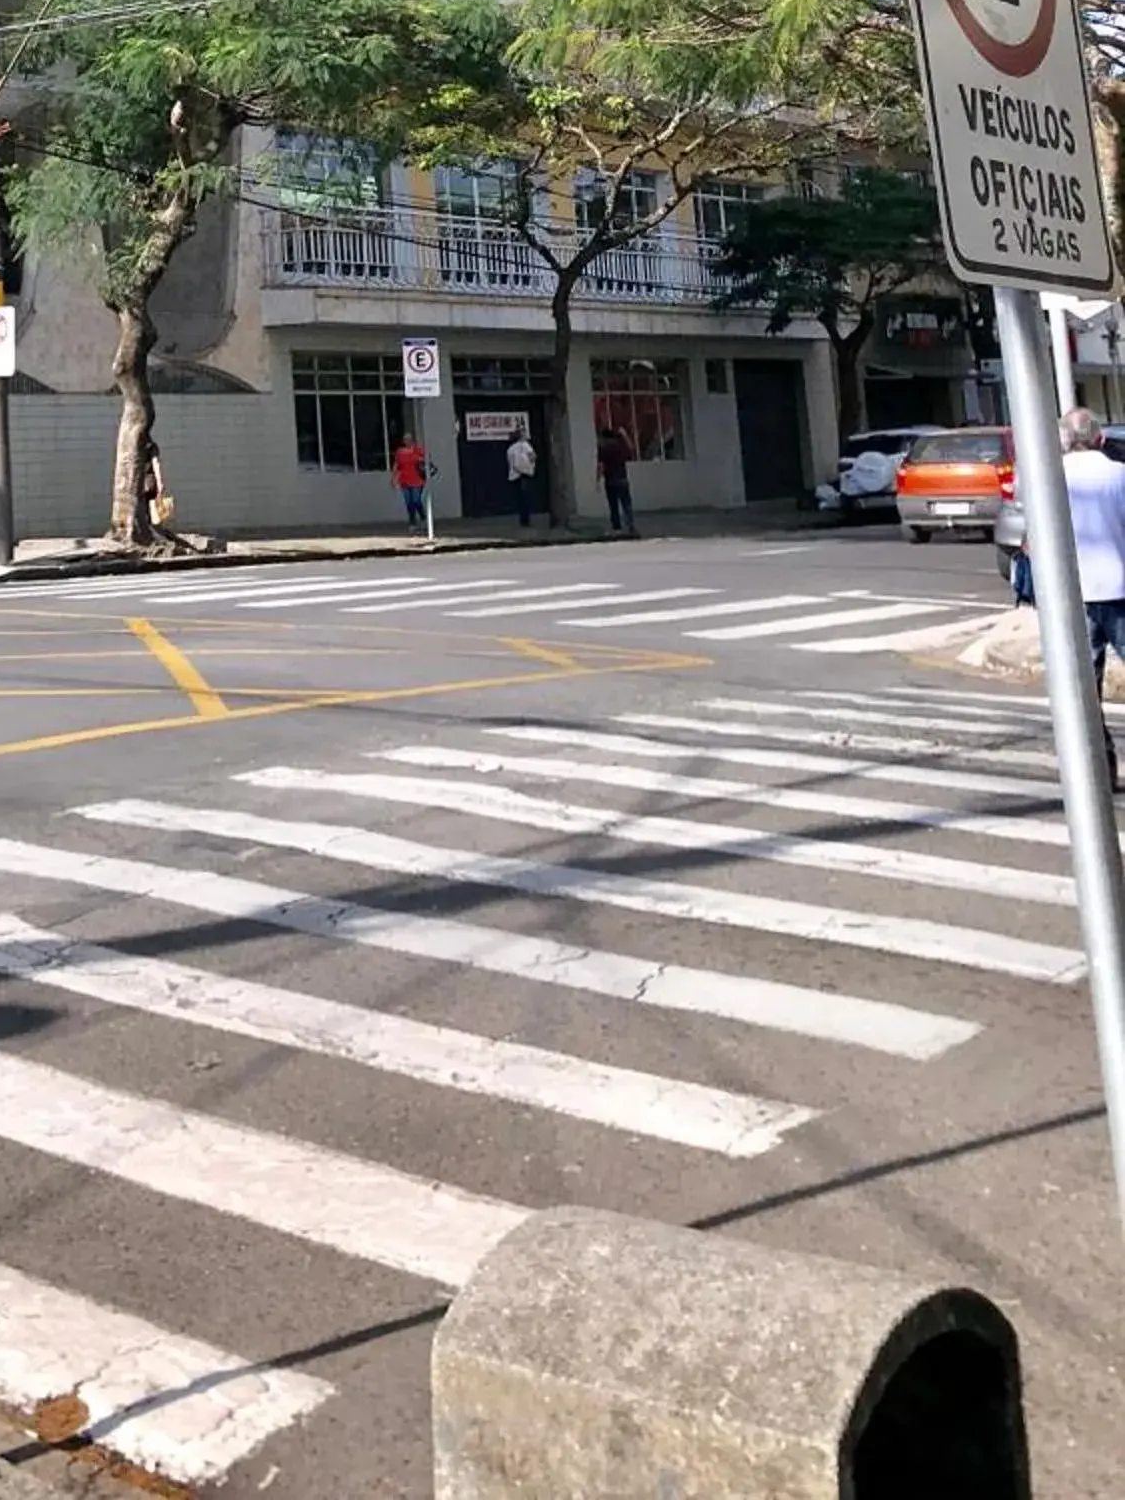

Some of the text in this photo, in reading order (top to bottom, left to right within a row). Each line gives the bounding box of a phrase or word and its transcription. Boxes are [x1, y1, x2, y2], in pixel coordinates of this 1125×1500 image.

[958, 83, 1076, 155] VEÍCULOS
[970, 155, 1086, 223] OFICIAIS
[992, 217, 1081, 263] 2 VAGAS
[416, 350, 427, 368] E
